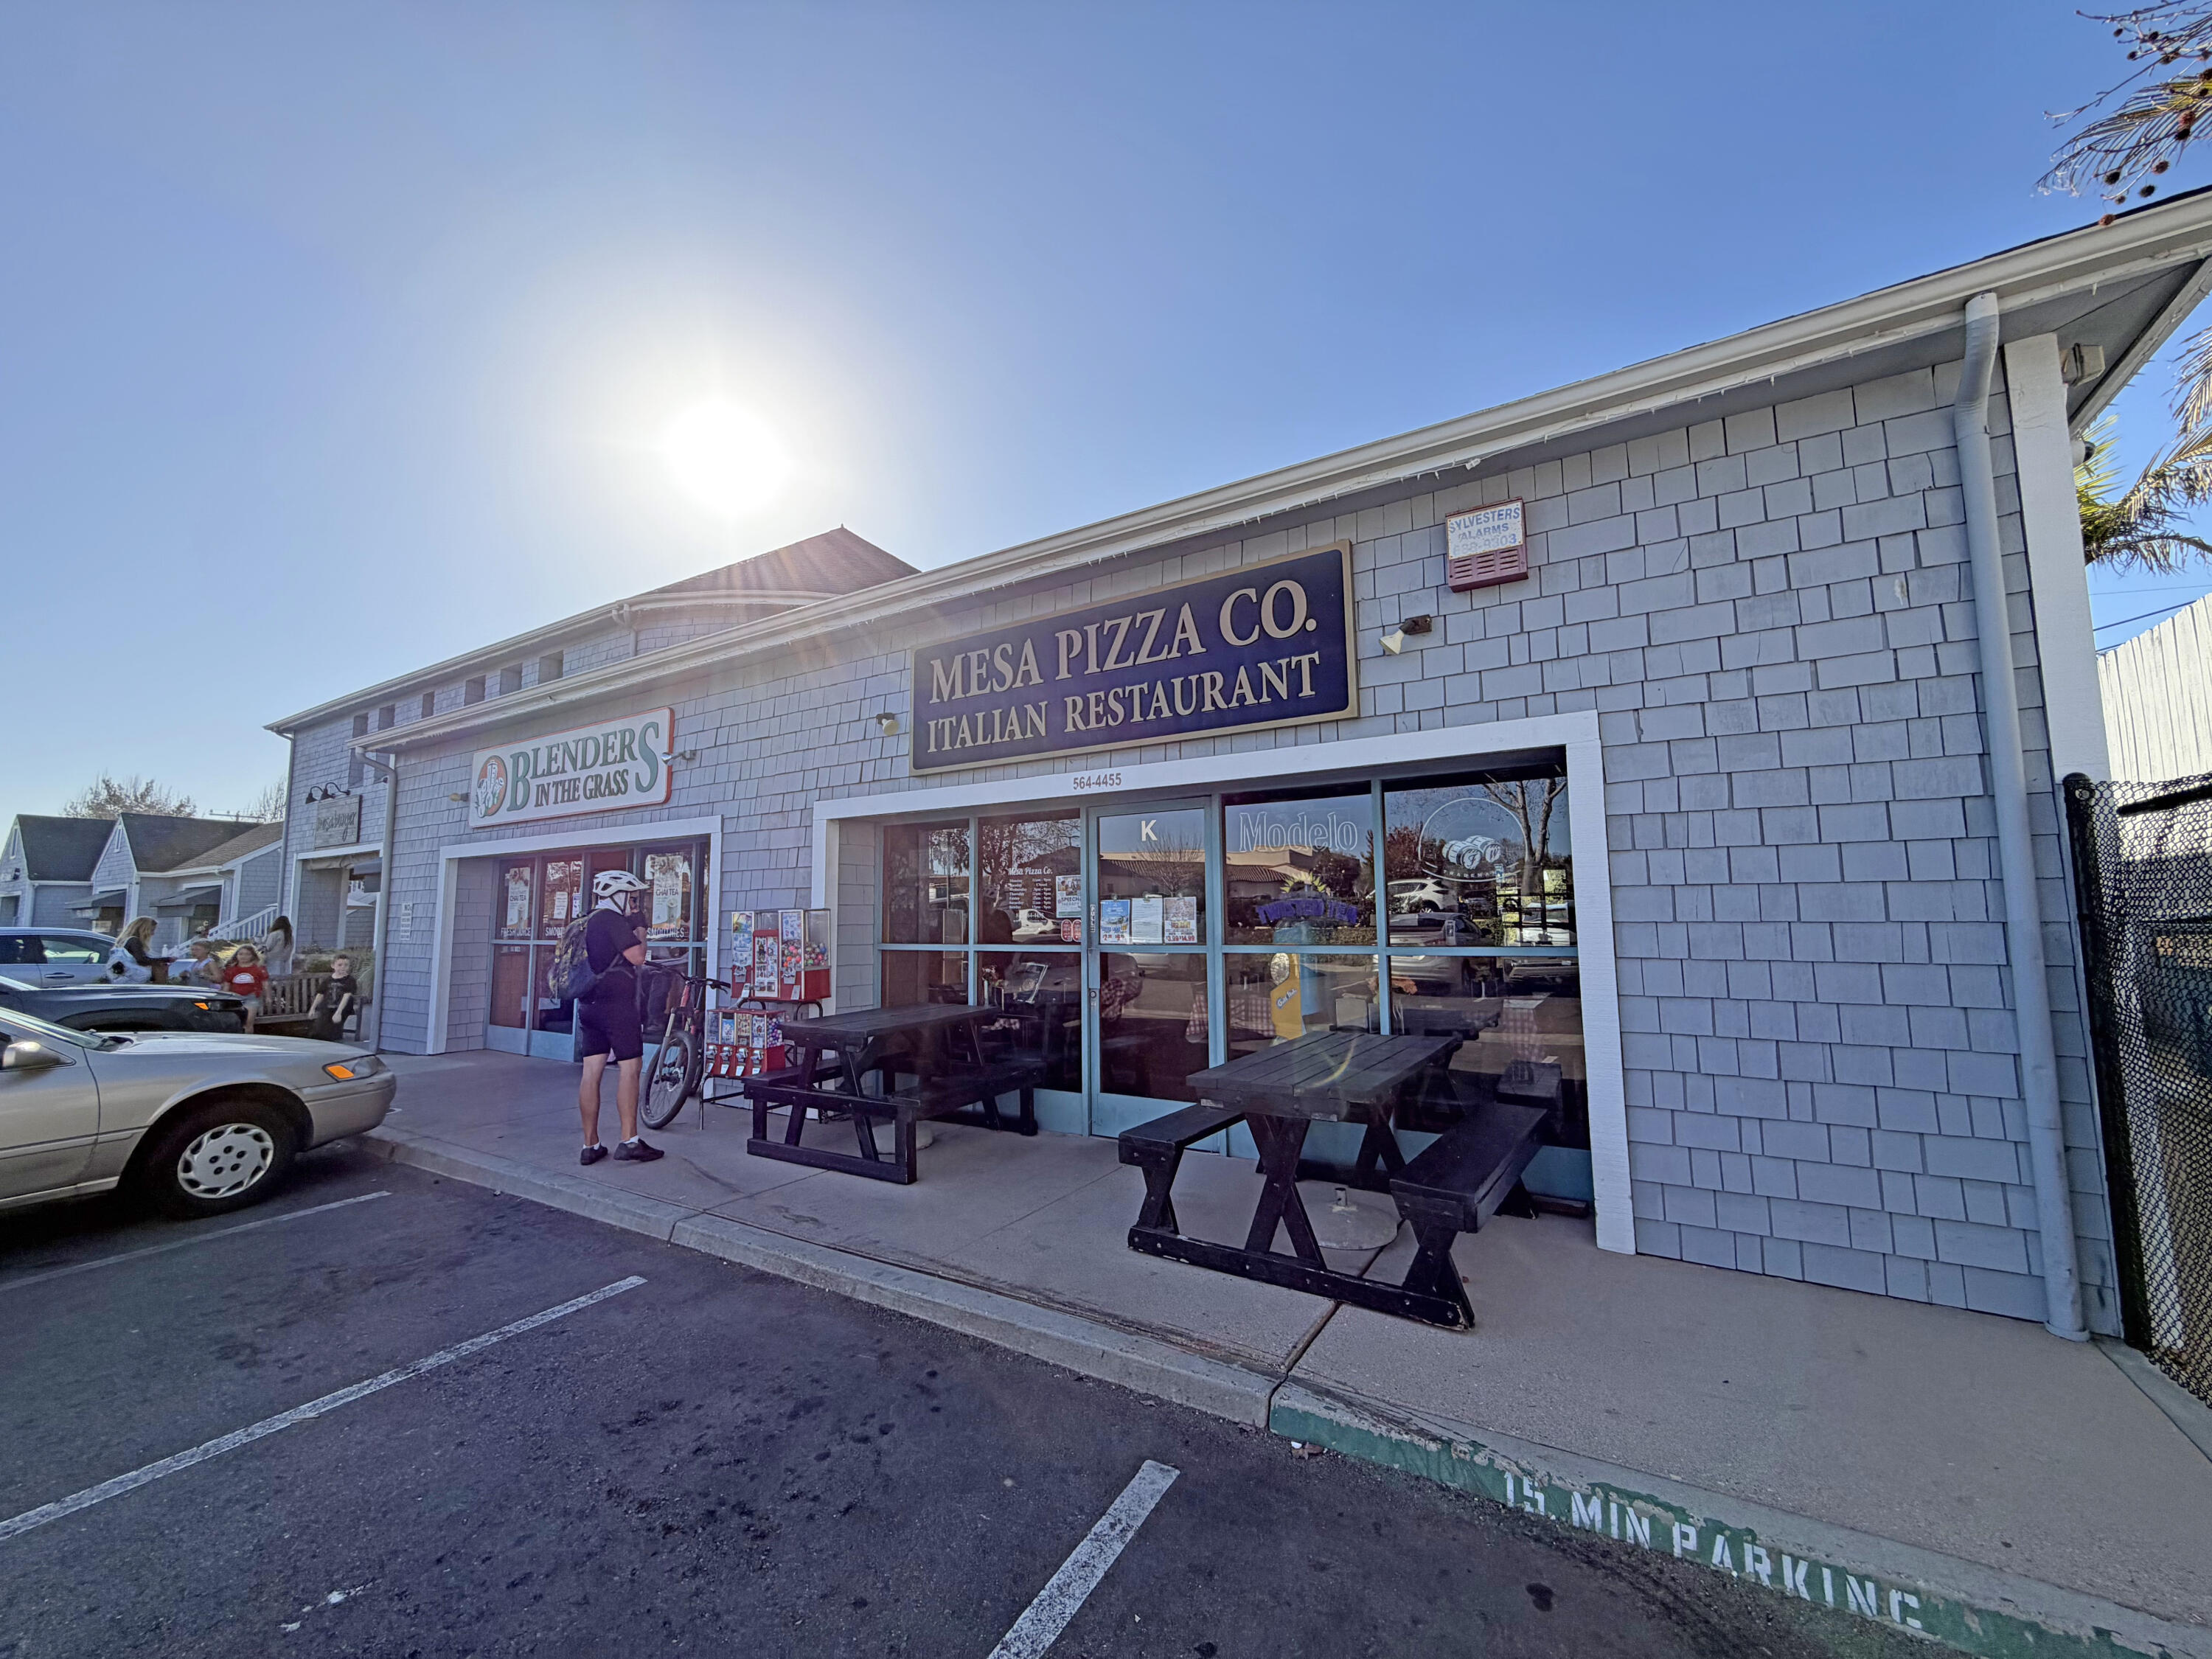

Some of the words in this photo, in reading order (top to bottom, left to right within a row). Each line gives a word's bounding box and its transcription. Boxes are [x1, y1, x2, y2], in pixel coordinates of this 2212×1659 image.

[1450, 507, 1520, 533] SYLVESTERS
[1461, 523, 1509, 541] ALARMS
[929, 639, 1043, 703] MESA
[1055, 602, 1206, 681] PIZZA
[1220, 580, 1317, 646] CO.
[928, 700, 1047, 753] ITALIAN
[1064, 652, 1320, 734] RESTAURANT
[507, 722, 659, 812] BLENDERS
[535, 783, 550, 807] IN
[551, 777, 580, 804] THE
[582, 769, 628, 799] GRASS
[1073, 773, 1122, 790] 564-4455
[1141, 819, 1158, 841] K
[1239, 811, 1358, 852] Modelo
[1008, 867, 1023, 875] Mesa
[1025, 867, 1042, 875] Pizza
[1043, 866, 1053, 874] Co.
[655, 888, 667, 897] CHAI
[668, 888, 679, 896] TEA
[501, 927, 516, 937] FRESH
[516, 926, 531, 936] JUICE
[646, 927, 685, 939] SMOOTHIES
[1571, 1490, 1652, 1549] MIN
